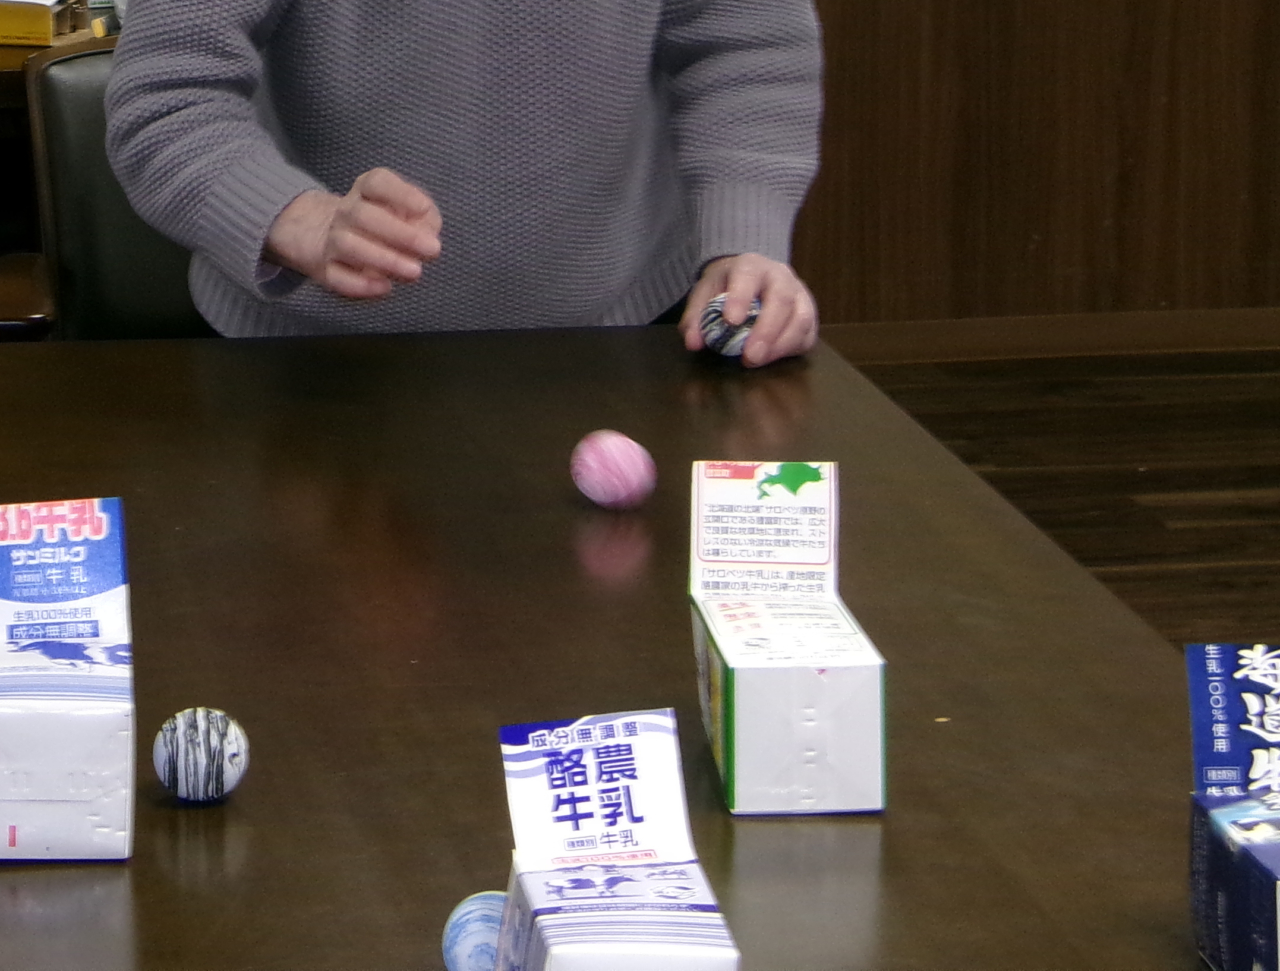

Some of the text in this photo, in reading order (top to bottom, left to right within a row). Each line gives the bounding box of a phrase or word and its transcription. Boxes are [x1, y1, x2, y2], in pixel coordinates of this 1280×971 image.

[11, 546, 86, 565] サンミルク
[46, 566, 87, 584] 牛乳
[13, 624, 93, 639] 成分無調整
[531, 721, 639, 748] 成分無調整
[543, 743, 639, 790] 酪農
[552, 785, 644, 831] 牛乳
[599, 829, 639, 849] 牛乳
